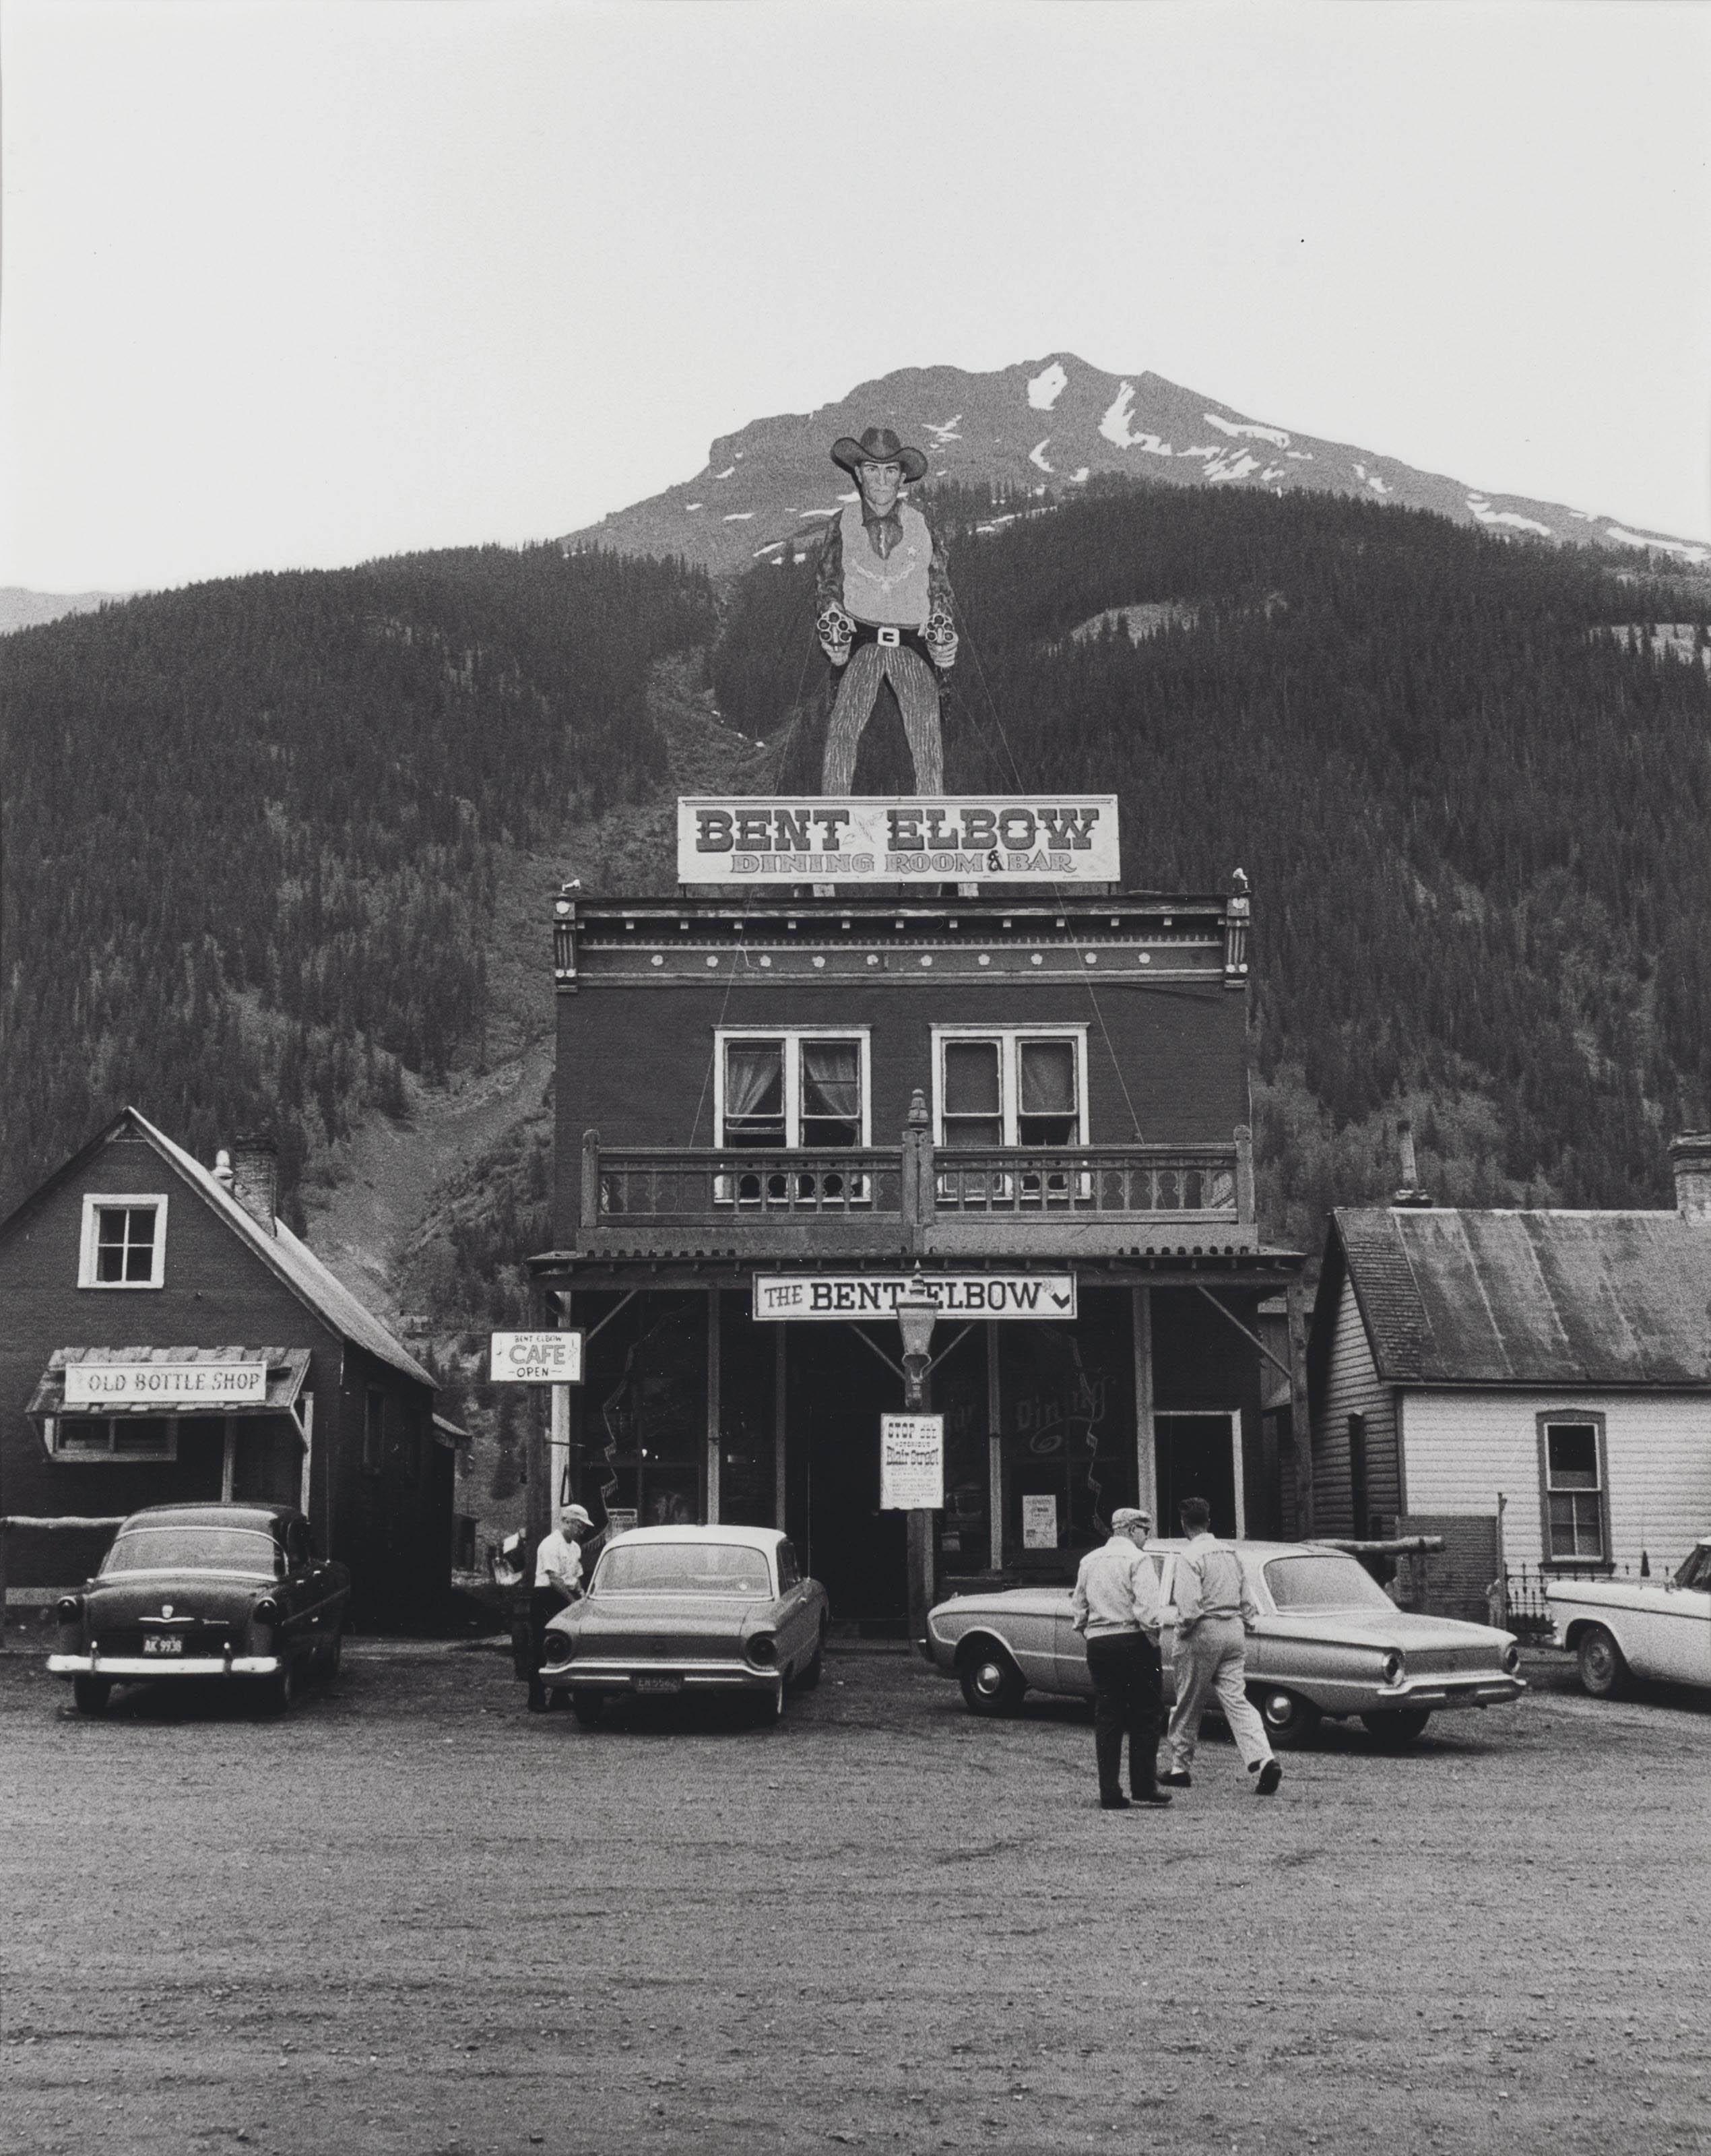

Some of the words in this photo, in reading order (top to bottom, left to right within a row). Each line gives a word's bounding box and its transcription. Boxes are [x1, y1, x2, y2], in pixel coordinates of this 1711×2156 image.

[696, 809, 849, 852] BENT
[887, 808, 1099, 851] ELBOW
[731, 853, 874, 873] DINING
[884, 852, 983, 874] ROOM
[988, 850, 1004, 871] &
[1008, 850, 1077, 873] BAR
[765, 1284, 802, 1308] THE
[810, 1282, 905, 1310] BENT
[924, 1281, 1042, 1310] ELBOW
[509, 1344, 566, 1365] CAFE
[89, 1374, 126, 1391] OLD
[135, 1373, 205, 1391] BOTTLE
[212, 1372, 261, 1390] SHOP
[517, 1367, 549, 1377] OPEN
[889, 1422, 915, 1438] STOP
